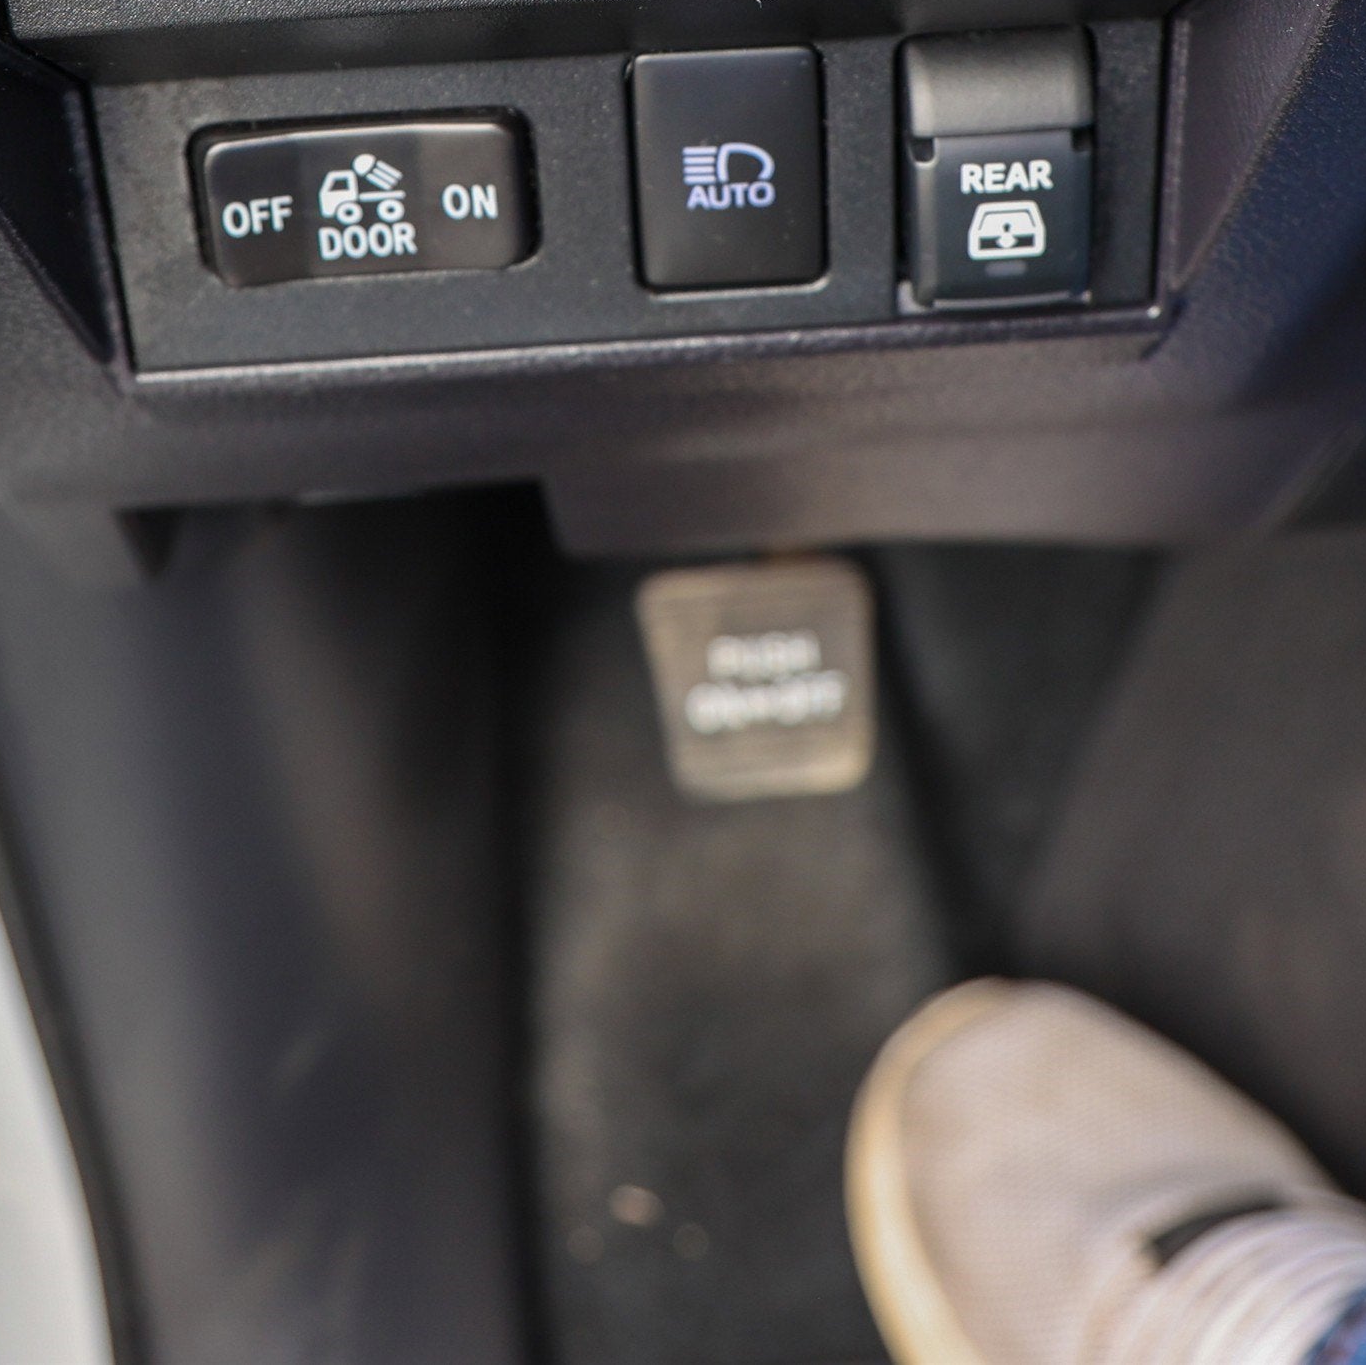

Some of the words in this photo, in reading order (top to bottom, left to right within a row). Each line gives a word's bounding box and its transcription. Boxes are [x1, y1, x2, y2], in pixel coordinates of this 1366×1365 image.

[960, 159, 1054, 195] REAR
[442, 183, 498, 220] ON
[686, 182, 776, 210] AUTO
[222, 195, 293, 238] OFF
[318, 221, 418, 261] DOOR
